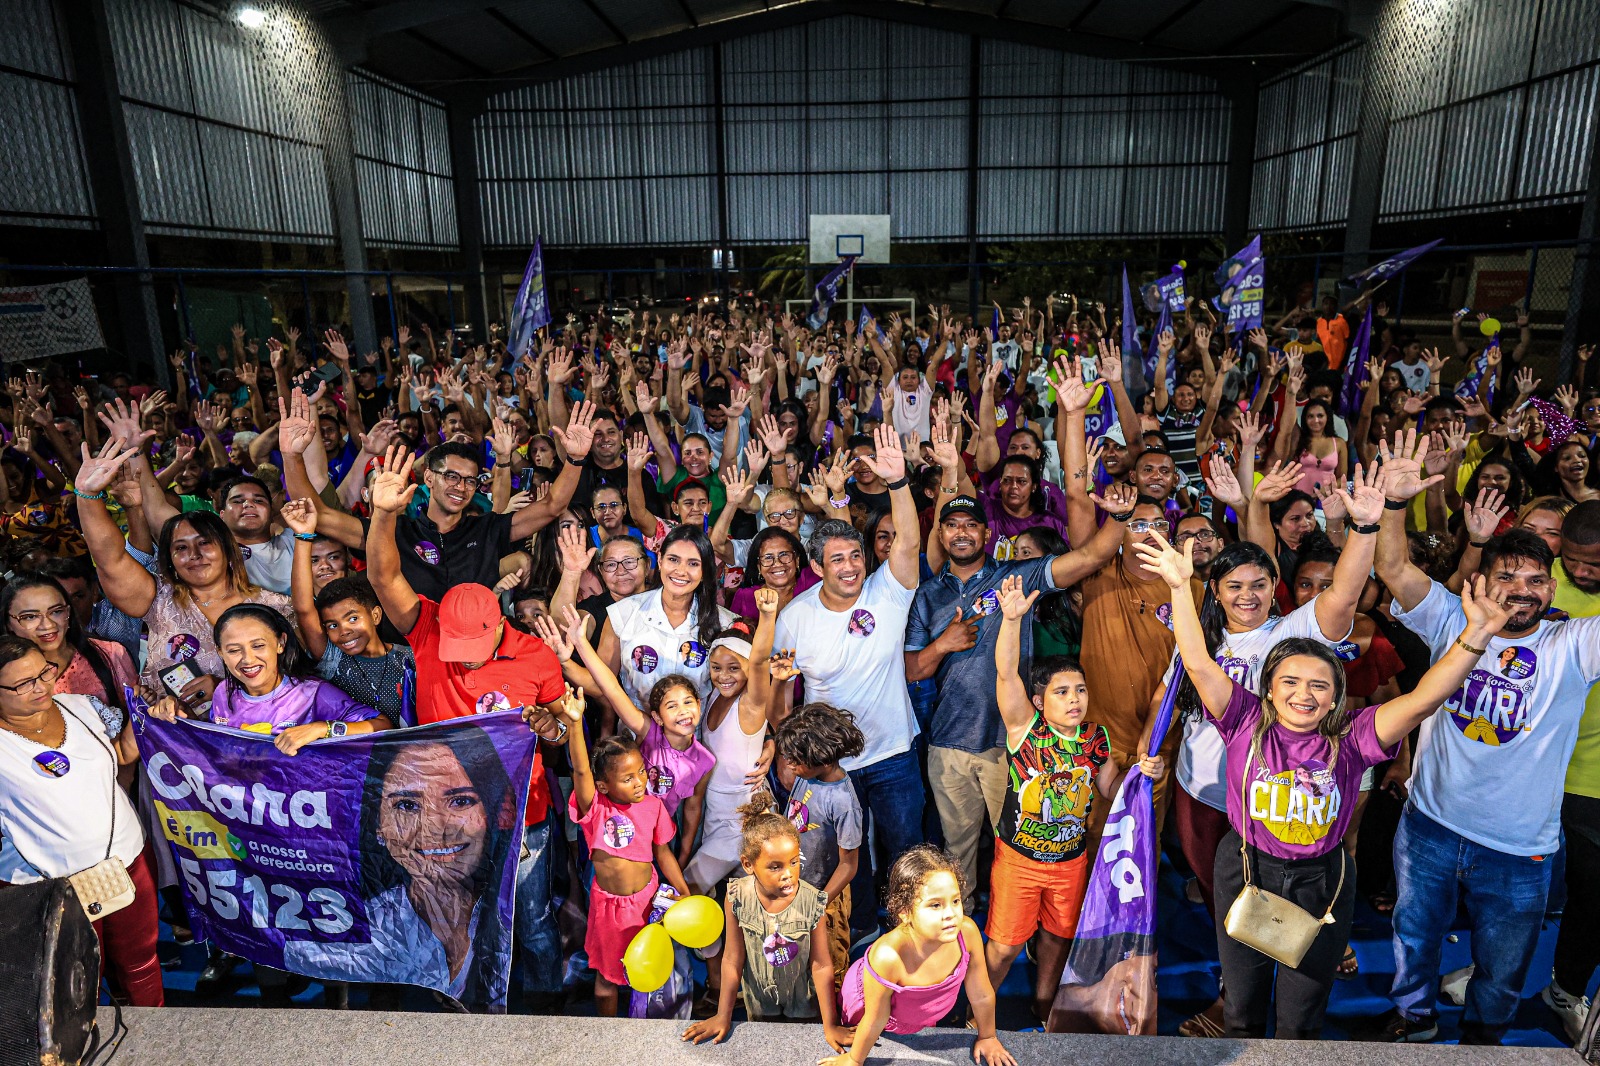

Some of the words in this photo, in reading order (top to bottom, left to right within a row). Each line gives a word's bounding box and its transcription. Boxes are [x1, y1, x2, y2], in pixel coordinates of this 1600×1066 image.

[1250, 780, 1341, 826] CLARA
[1020, 818, 1059, 839] LISO
[248, 839, 259, 851] a
[261, 844, 308, 859] nossa
[251, 853, 335, 873] vereadora
[180, 856, 354, 934] 55123
